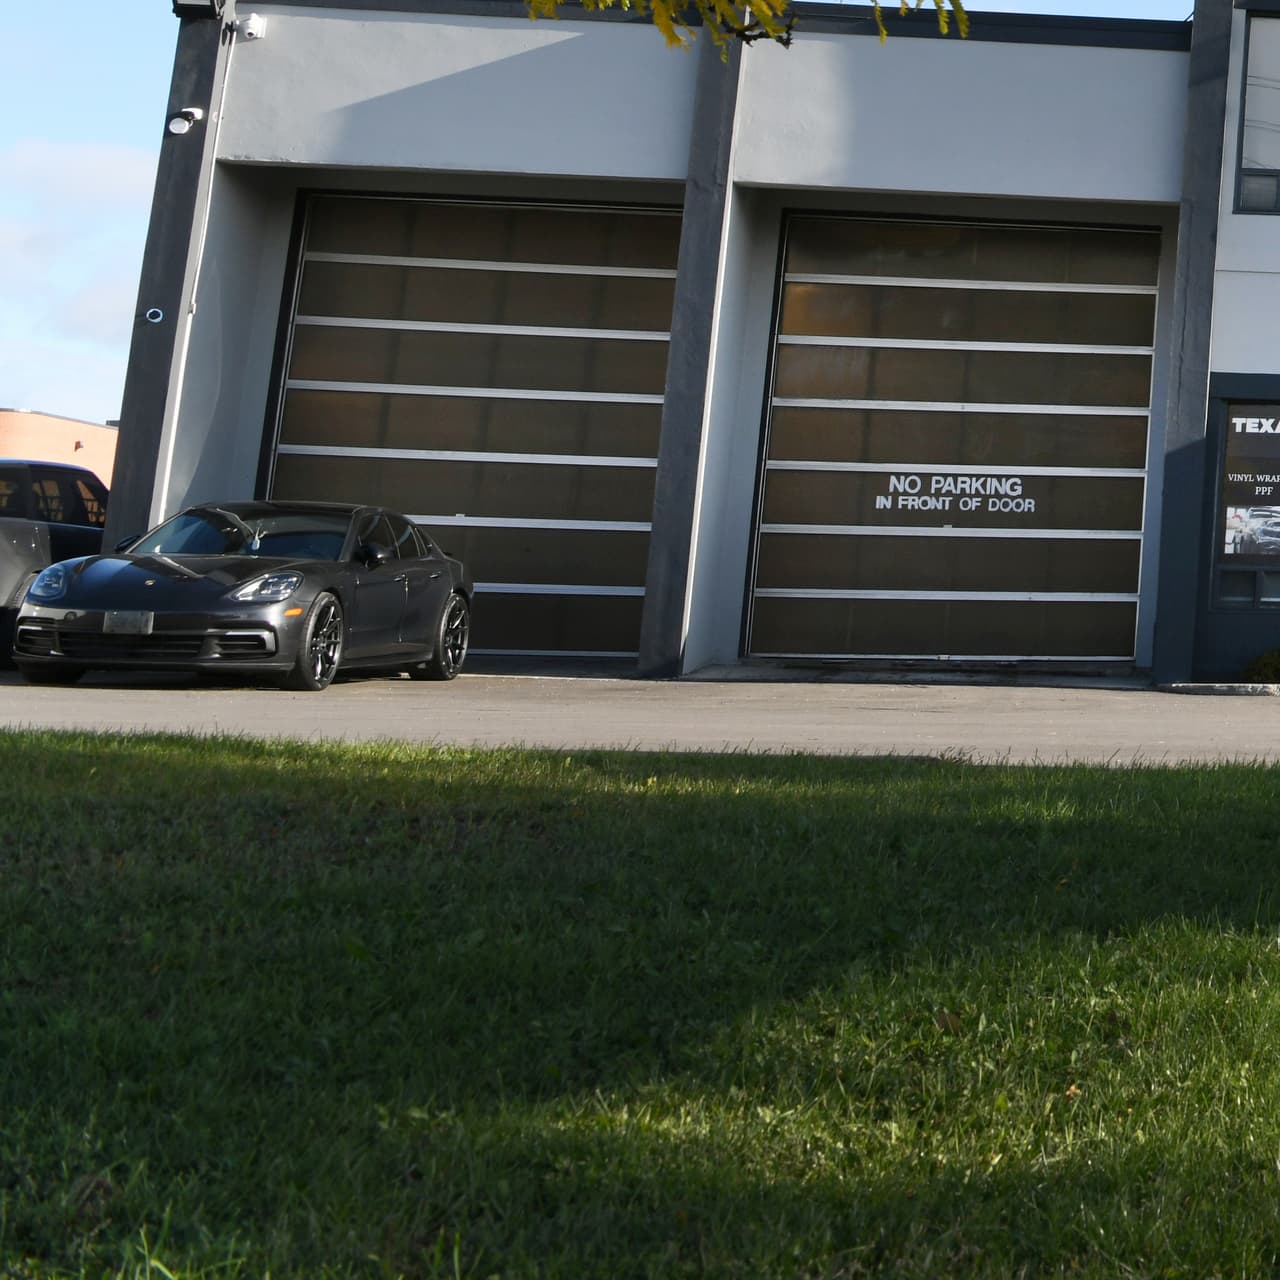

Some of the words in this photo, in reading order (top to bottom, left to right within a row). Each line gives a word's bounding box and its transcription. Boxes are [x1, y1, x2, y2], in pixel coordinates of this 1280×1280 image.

[1228, 473, 1255, 482] VINYL
[888, 475, 922, 494] NO
[930, 476, 1023, 497] PARKING
[1255, 486, 1274, 495] PPF
[875, 495, 892, 510] IN
[898, 495, 953, 511] FRONT
[959, 497, 982, 511] OF
[988, 498, 1036, 513] DOOR
